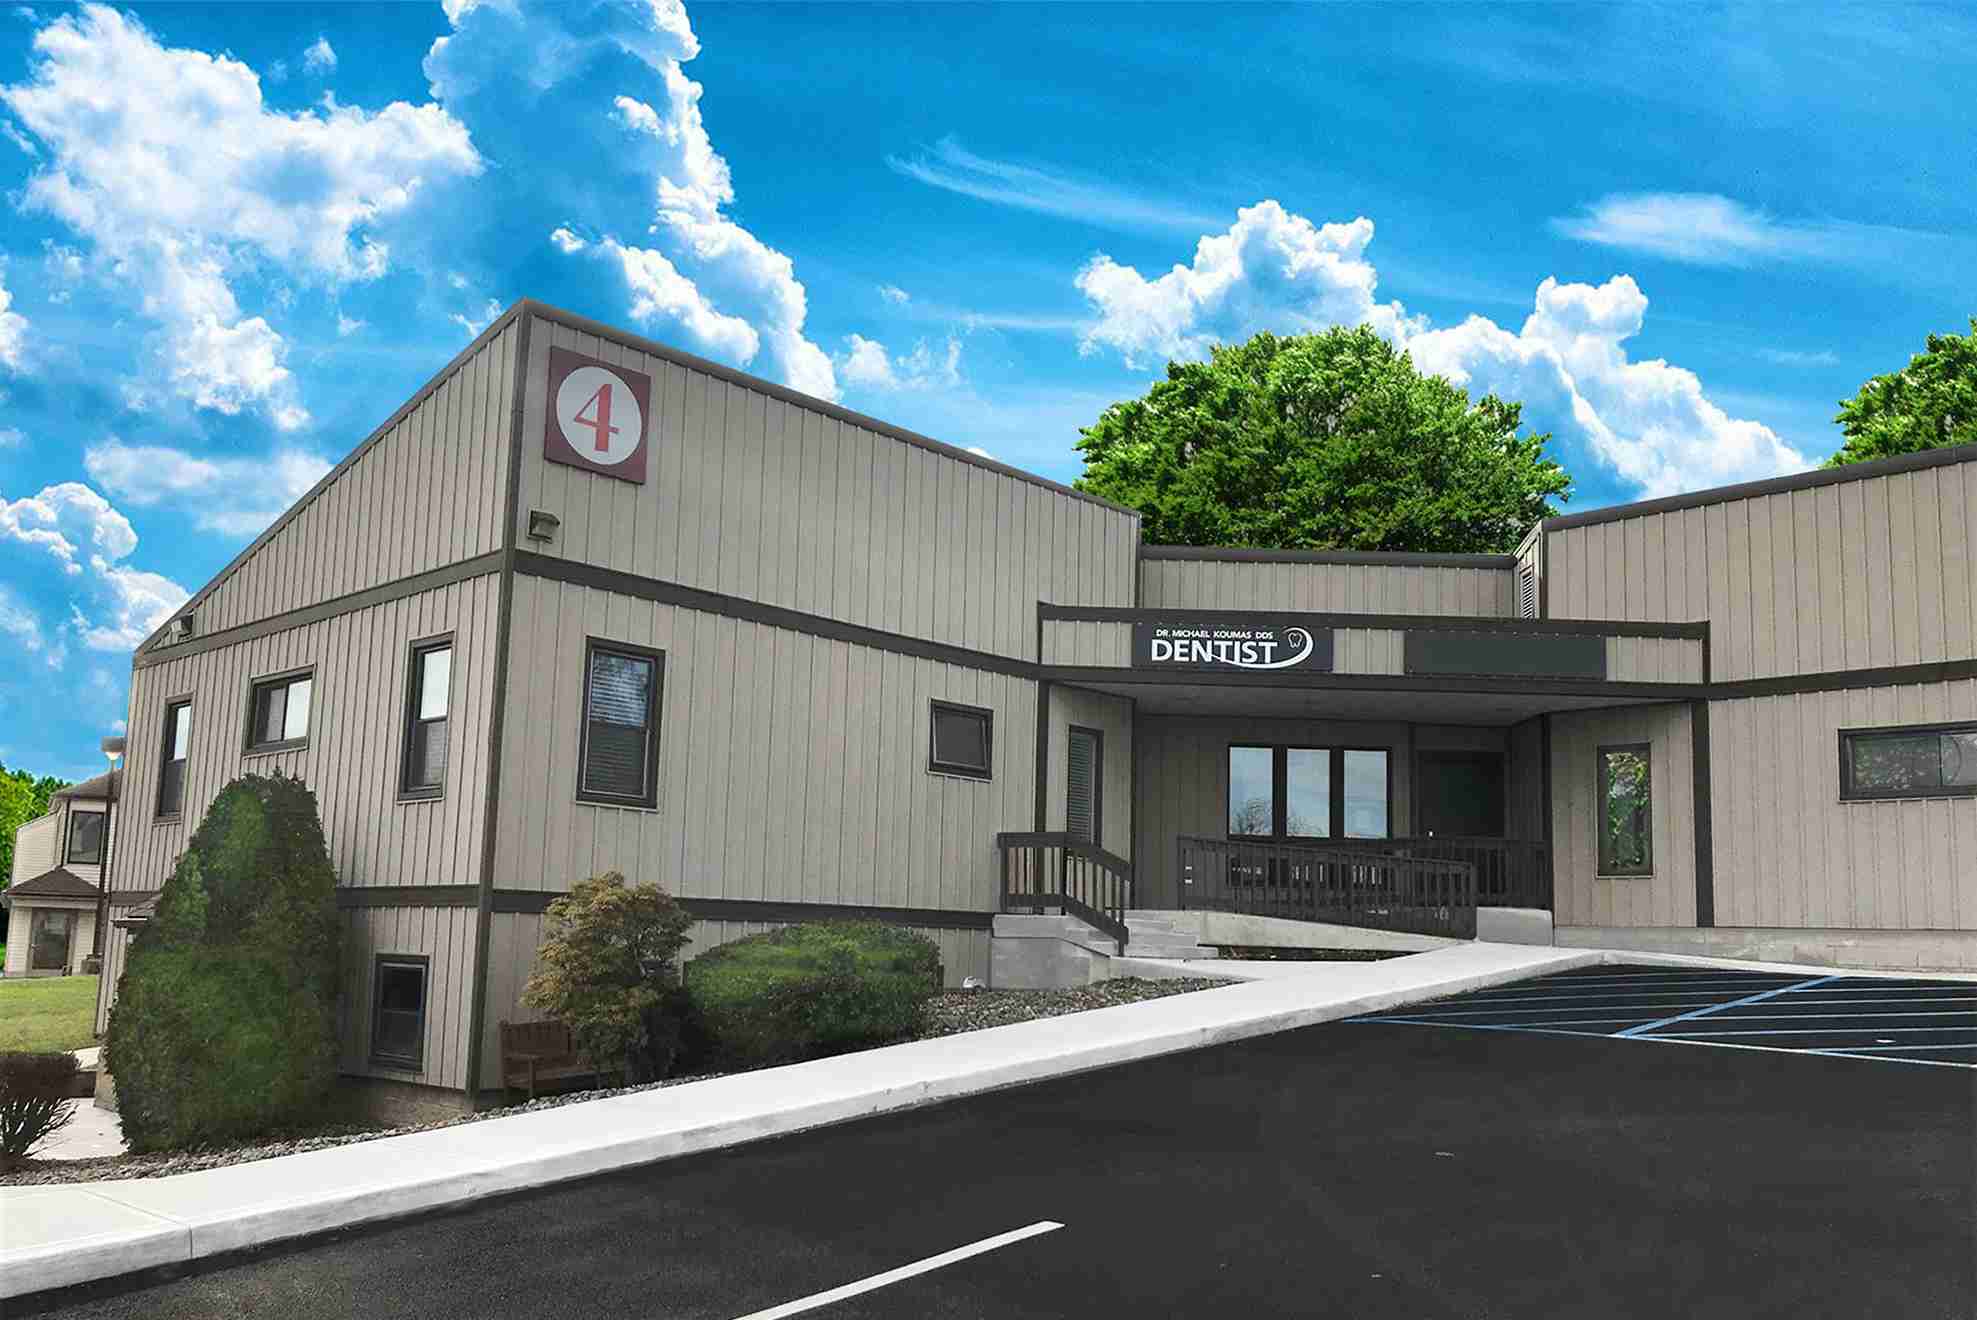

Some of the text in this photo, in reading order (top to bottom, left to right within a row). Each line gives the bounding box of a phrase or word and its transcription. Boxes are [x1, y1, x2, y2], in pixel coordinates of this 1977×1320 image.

[574, 383, 620, 452] 4
[1155, 629, 1274, 640] DR. MICHAEL KOUMAS DDS
[1151, 639, 1278, 664] DENTIST
